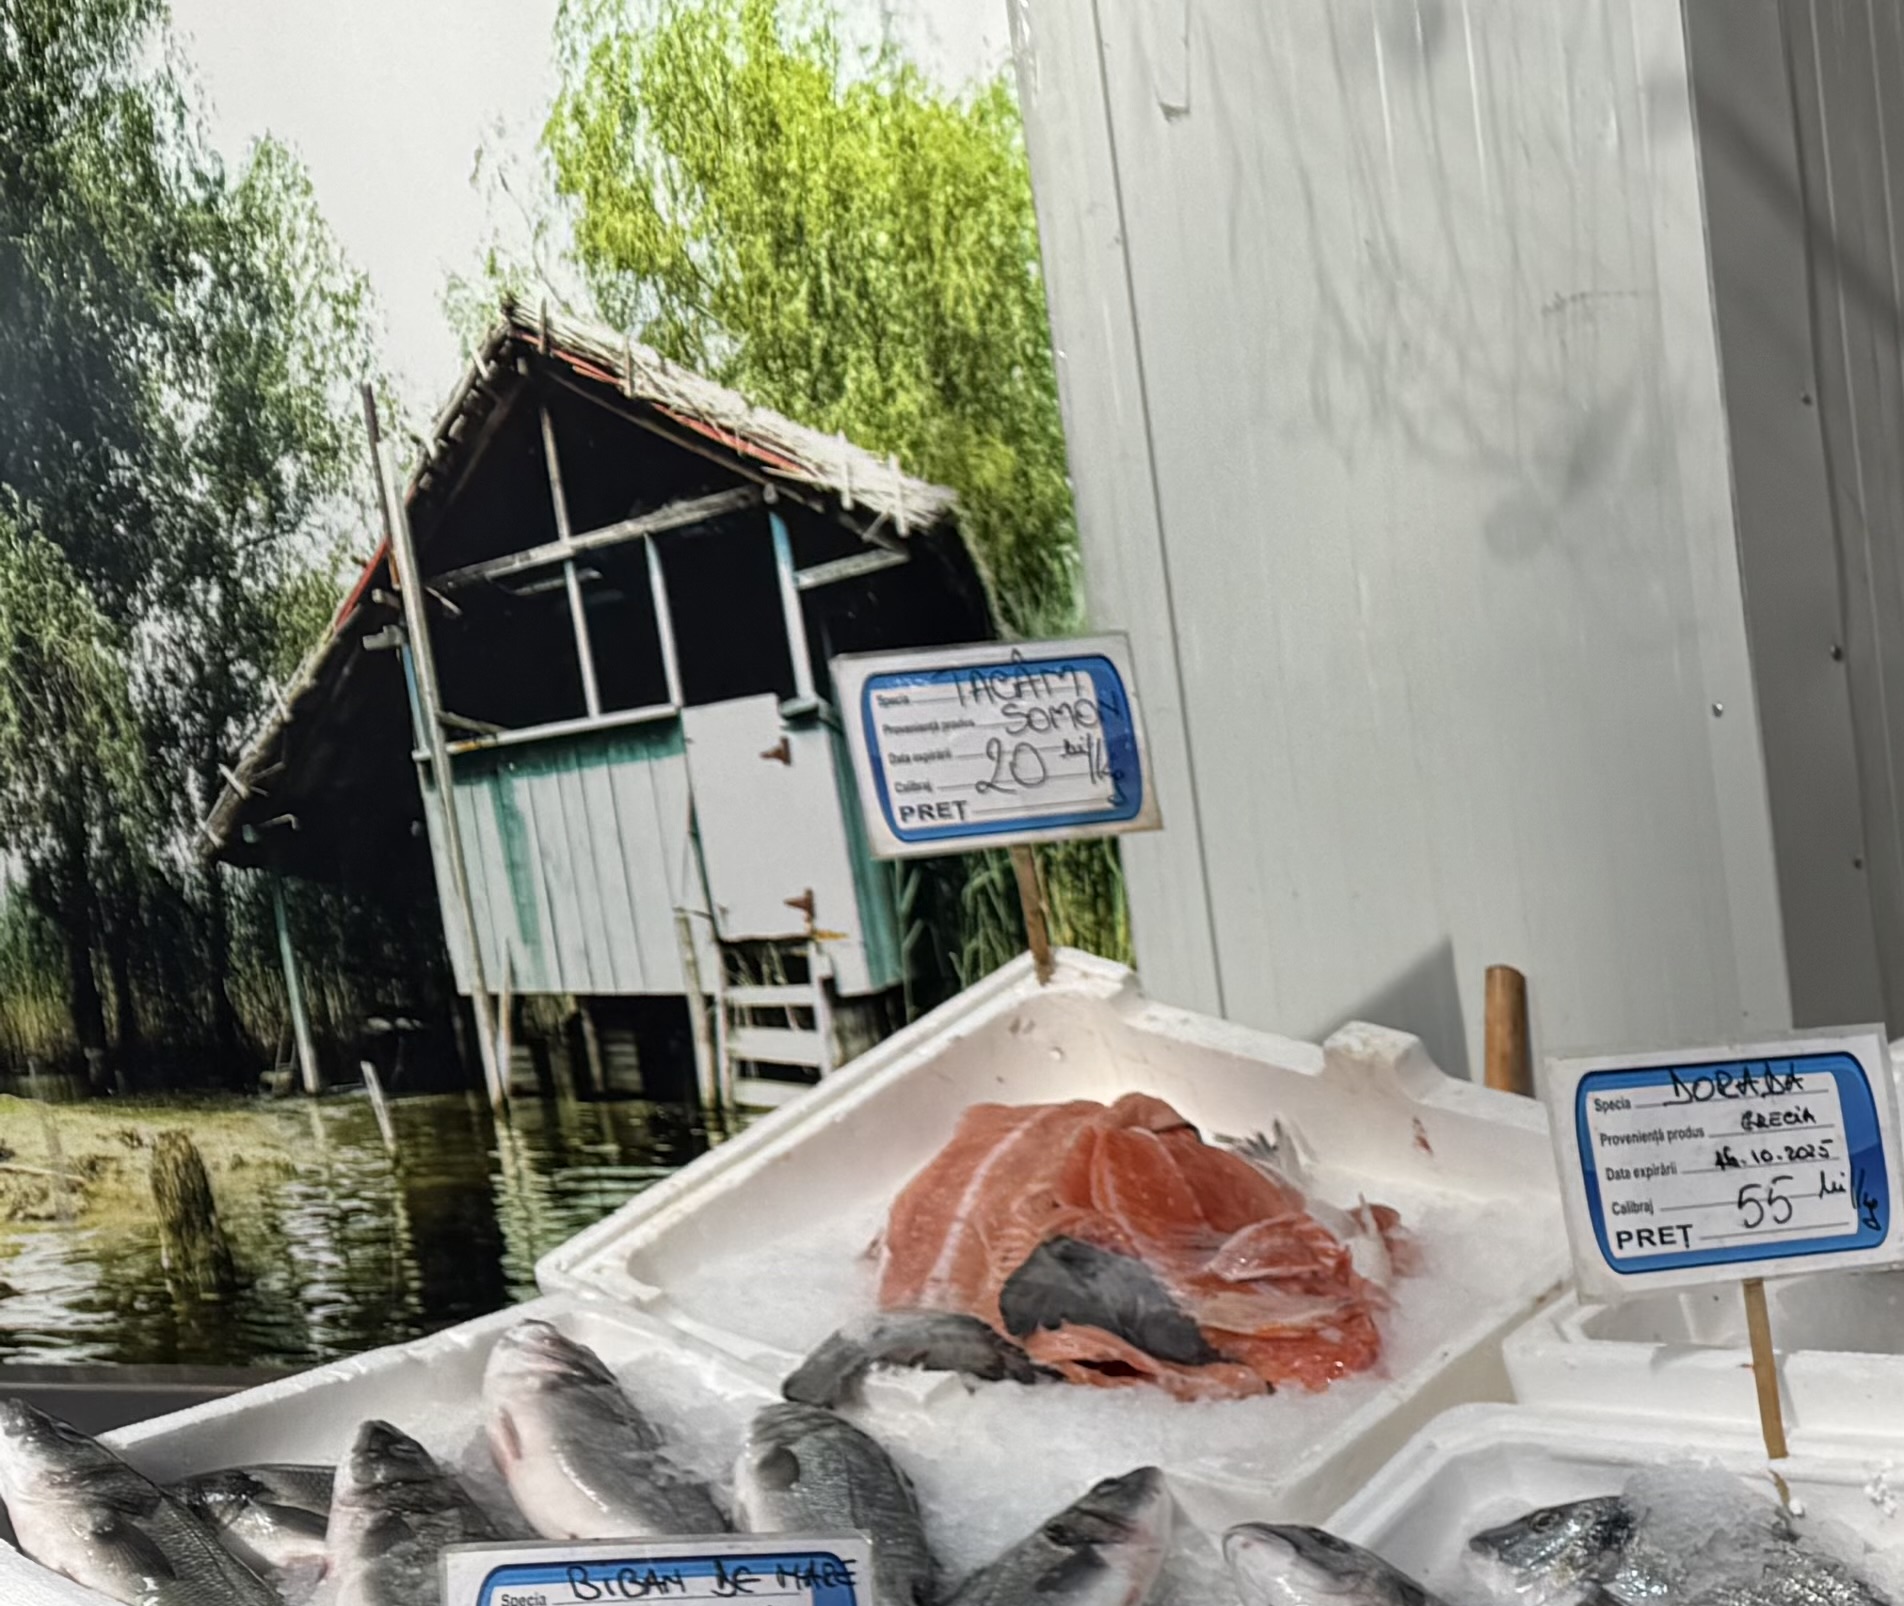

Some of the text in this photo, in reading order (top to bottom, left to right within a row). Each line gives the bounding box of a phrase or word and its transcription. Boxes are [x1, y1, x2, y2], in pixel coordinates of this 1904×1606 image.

[1001, 690, 1121, 736] SOMON
[975, 737, 1047, 795] 20
[1594, 1060, 1805, 1113] Specia DORADA
[1599, 1105, 1818, 1147] Proveniență produs GRECIA
[1605, 1166, 1632, 1182] Data
[1611, 1199, 1654, 1217] Calibraj
[1615, 1224, 1693, 1250] PREȚ
[1737, 1175, 1794, 1229] 55
[566, 1565, 687, 1600] BIBAN
[711, 1560, 761, 1597] DE
[776, 1559, 858, 1591] MARE
